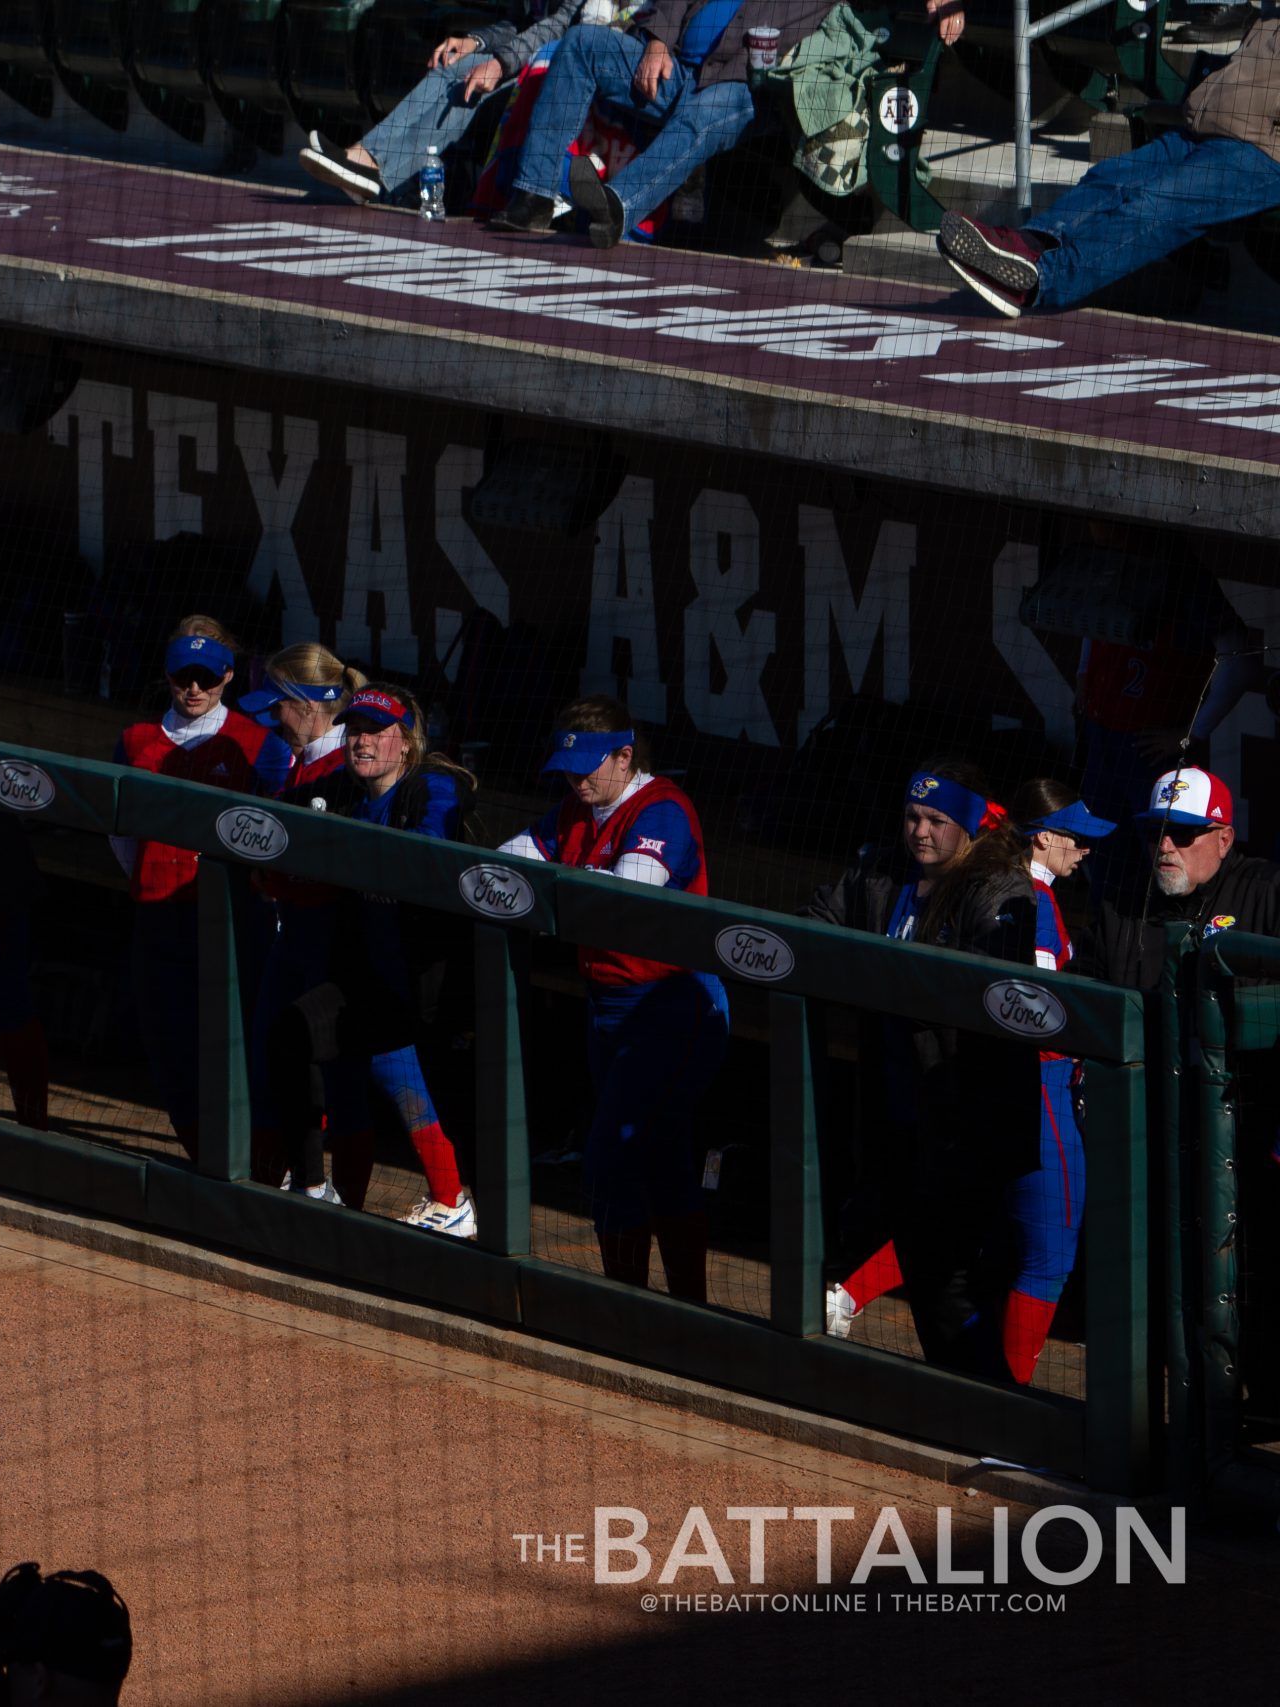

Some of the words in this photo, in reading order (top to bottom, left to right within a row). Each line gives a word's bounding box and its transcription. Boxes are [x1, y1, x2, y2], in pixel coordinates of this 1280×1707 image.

[48, 378, 510, 684] TEXAS
[578, 473, 918, 748] A&M
[0, 765, 41, 803] Ford
[229, 812, 273, 852] Ford
[473, 871, 521, 911] Ford
[730, 931, 779, 973] Ford
[999, 987, 1050, 1030] Ford
